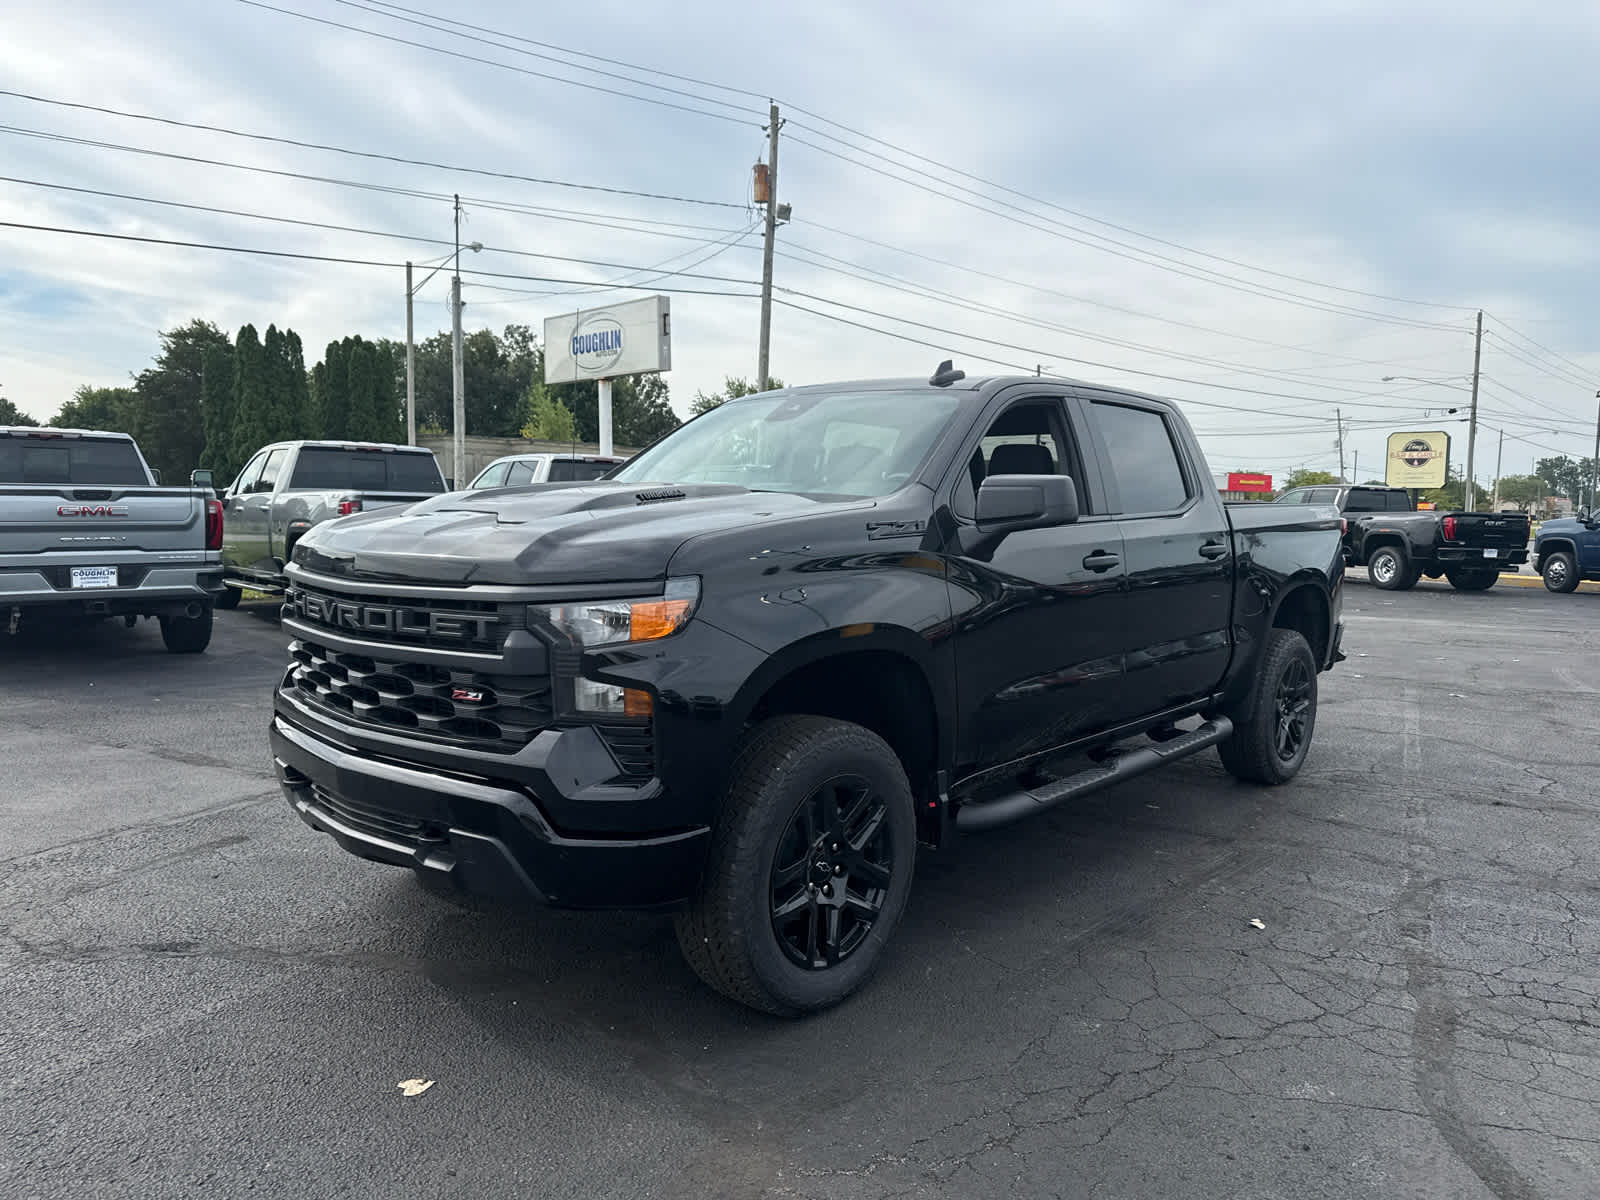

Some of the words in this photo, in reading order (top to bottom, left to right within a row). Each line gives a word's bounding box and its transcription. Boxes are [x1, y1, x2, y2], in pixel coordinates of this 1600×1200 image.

[572, 329, 622, 356] COUGHLIN
[56, 505, 129, 517] GMC
[283, 588, 499, 640] CHEVROLET
